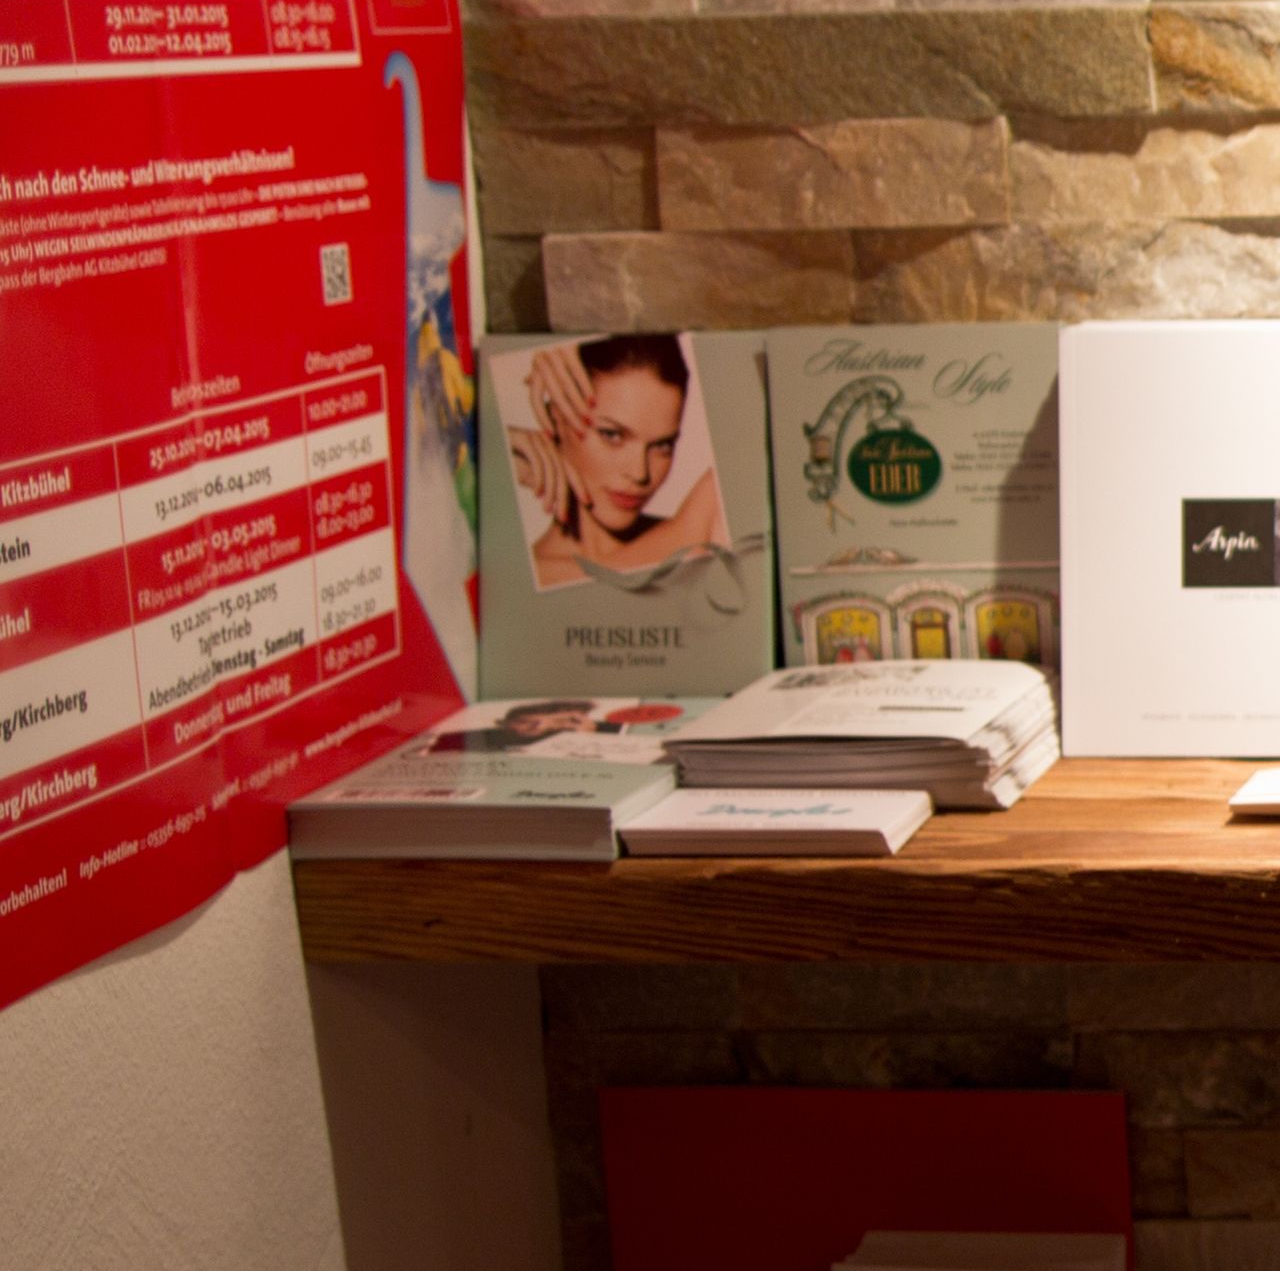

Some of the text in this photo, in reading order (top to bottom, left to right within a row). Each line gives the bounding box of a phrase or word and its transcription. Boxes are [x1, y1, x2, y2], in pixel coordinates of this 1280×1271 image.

[15, 170, 50, 199] nach
[51, 169, 77, 195] den
[2, 469, 72, 509] Kitzbühel
[1191, 525, 1261, 563] Arpin
[564, 628, 686, 651] PREISLISTE
